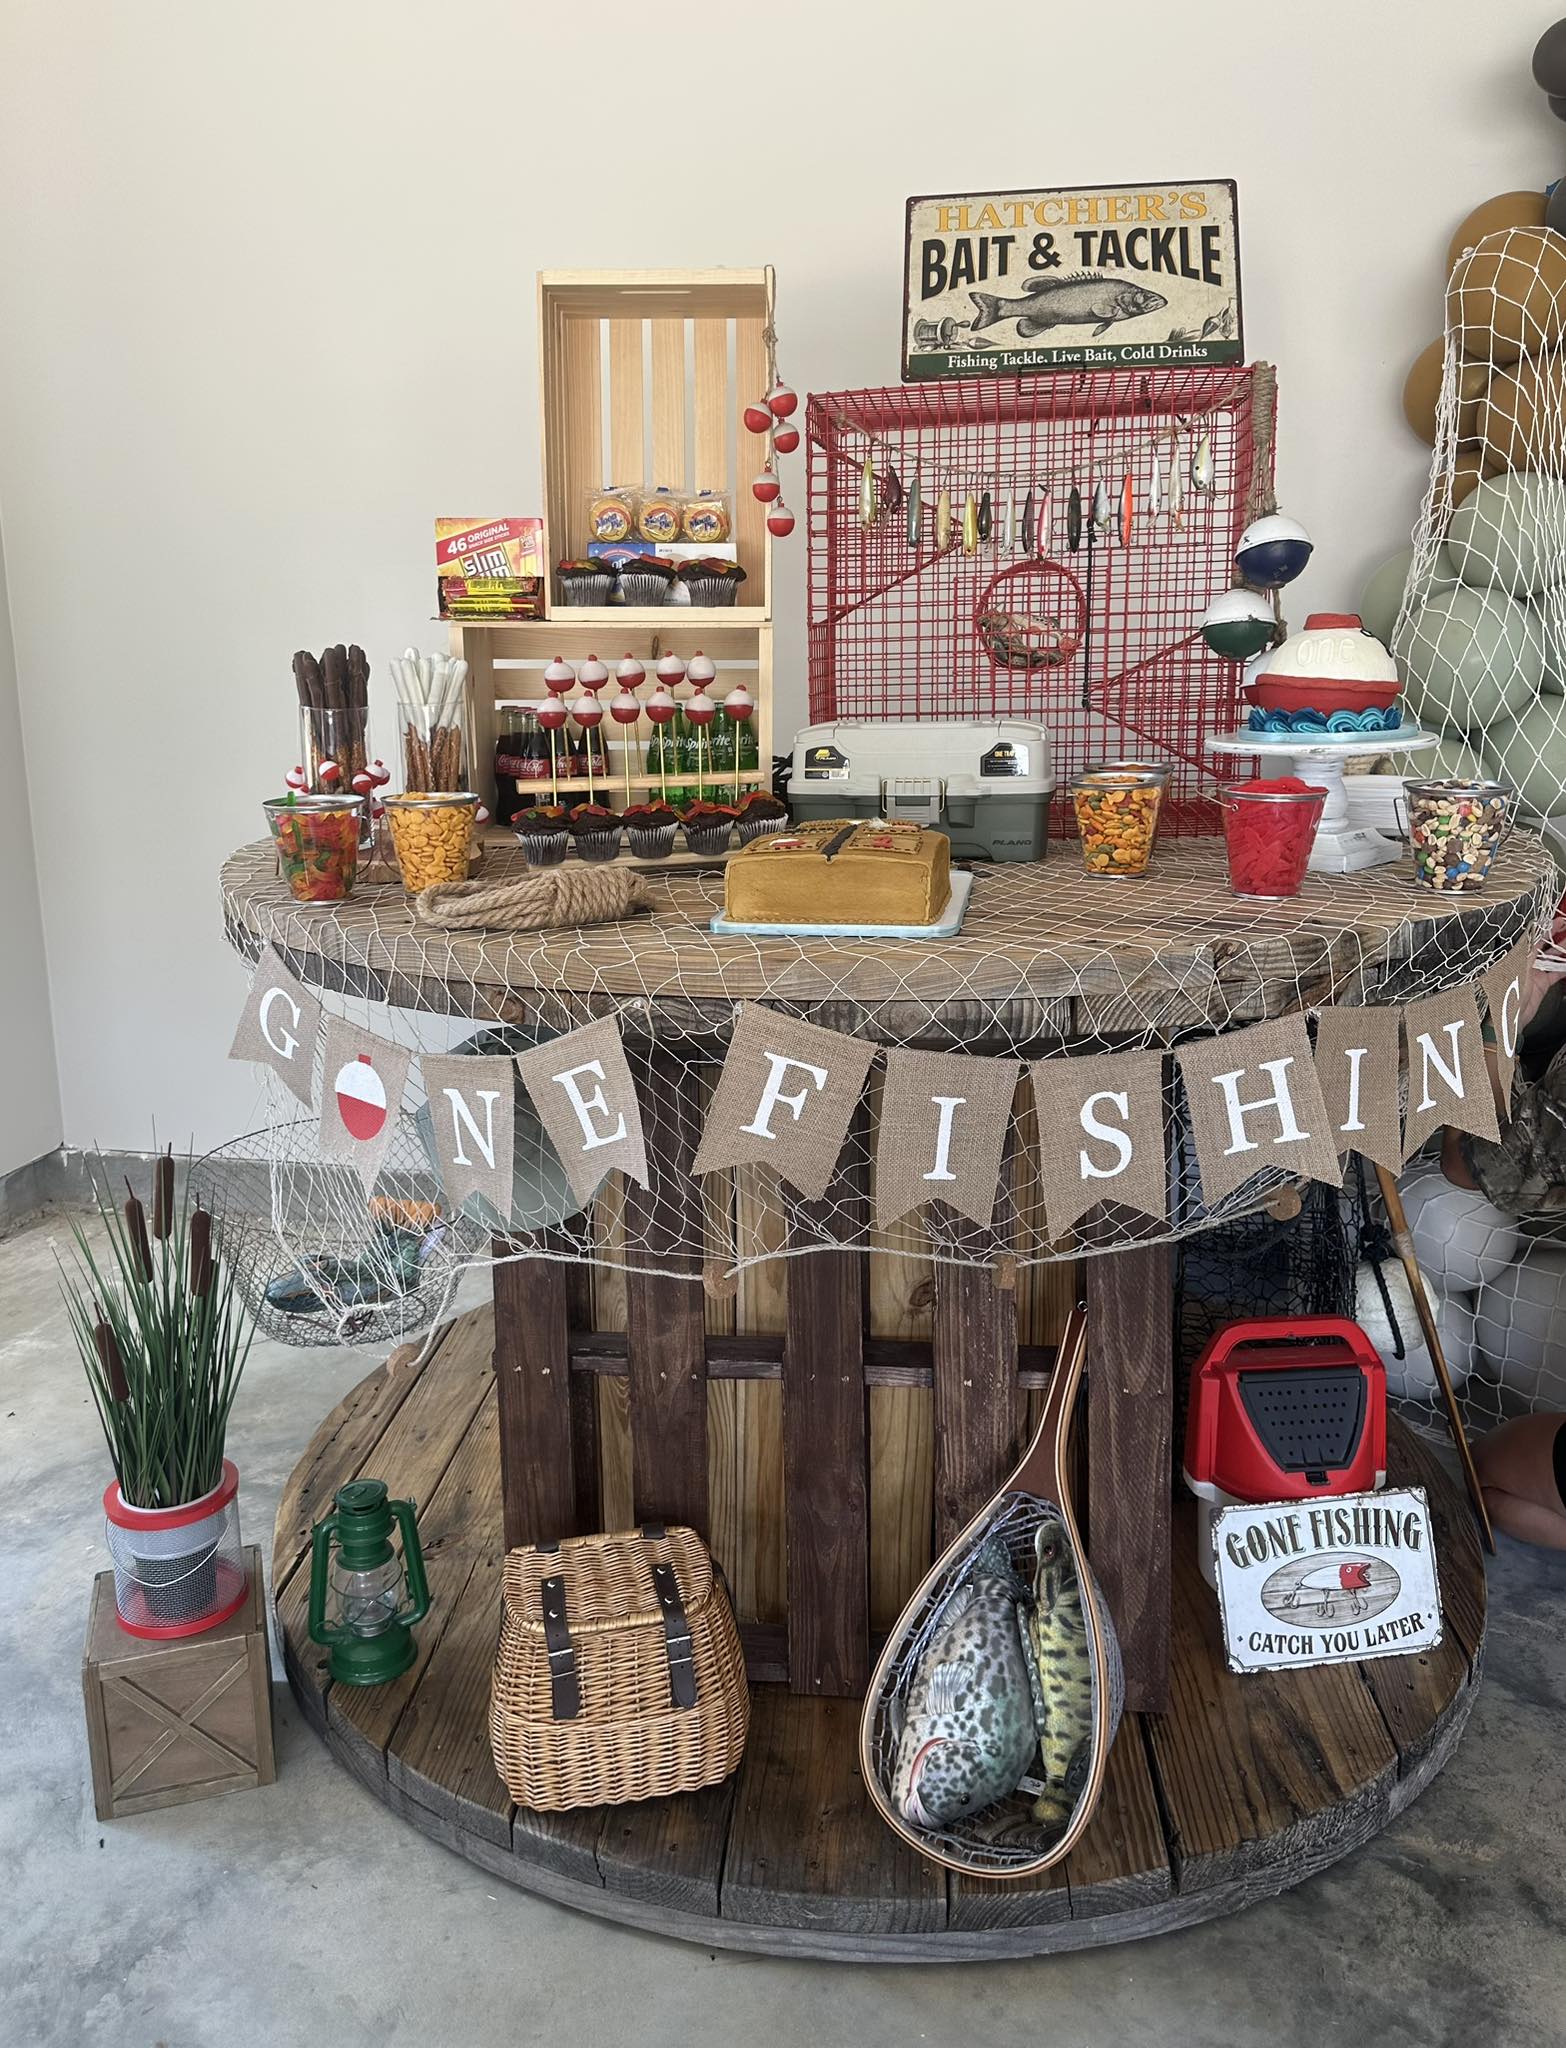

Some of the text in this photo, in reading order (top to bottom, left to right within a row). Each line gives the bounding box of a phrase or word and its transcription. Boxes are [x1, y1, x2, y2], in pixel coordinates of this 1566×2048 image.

[936, 191, 1208, 232] HATCHER'S
[921, 225, 1222, 301] BAIT & TACKLE
[948, 354, 998, 370] Fishing
[1052, 350, 1082, 364] Live
[1085, 348, 1117, 362] Bait,
[1121, 346, 1155, 360] Cold
[1159, 344, 1208, 359] Drinks
[447, 537, 468, 555] 46
[467, 523, 509, 543] ORIGINAL
[1297, 637, 1356, 666] one
[1225, 1507, 1424, 1569] GONE FISHING
[1250, 1612, 1425, 1655] CATCH YOU LATER
